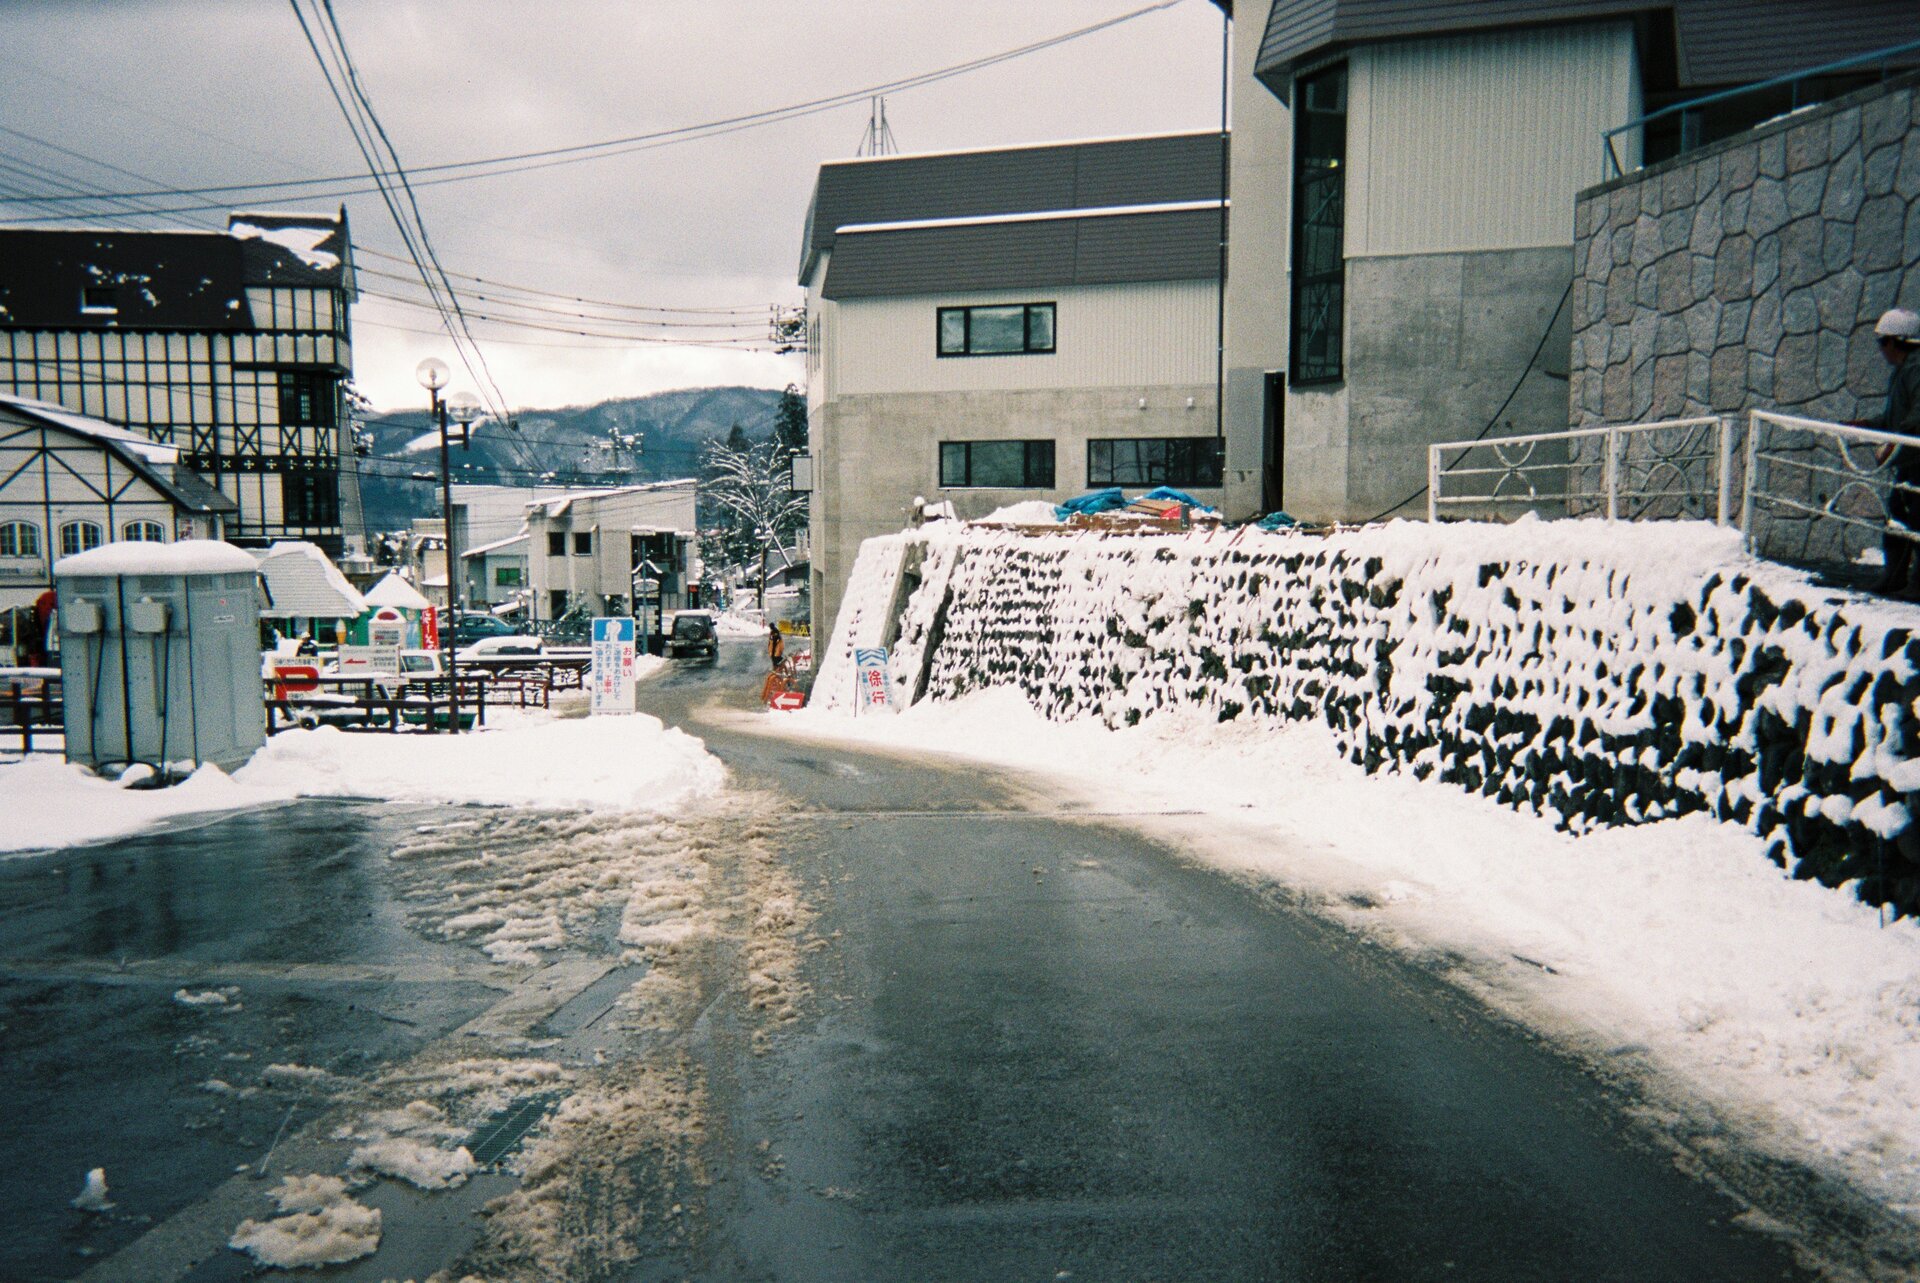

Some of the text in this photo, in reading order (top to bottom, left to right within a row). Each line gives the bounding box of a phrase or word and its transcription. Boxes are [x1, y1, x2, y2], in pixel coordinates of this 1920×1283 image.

[622, 646, 632, 677] お願い
[868, 670, 886, 705] 徐行
